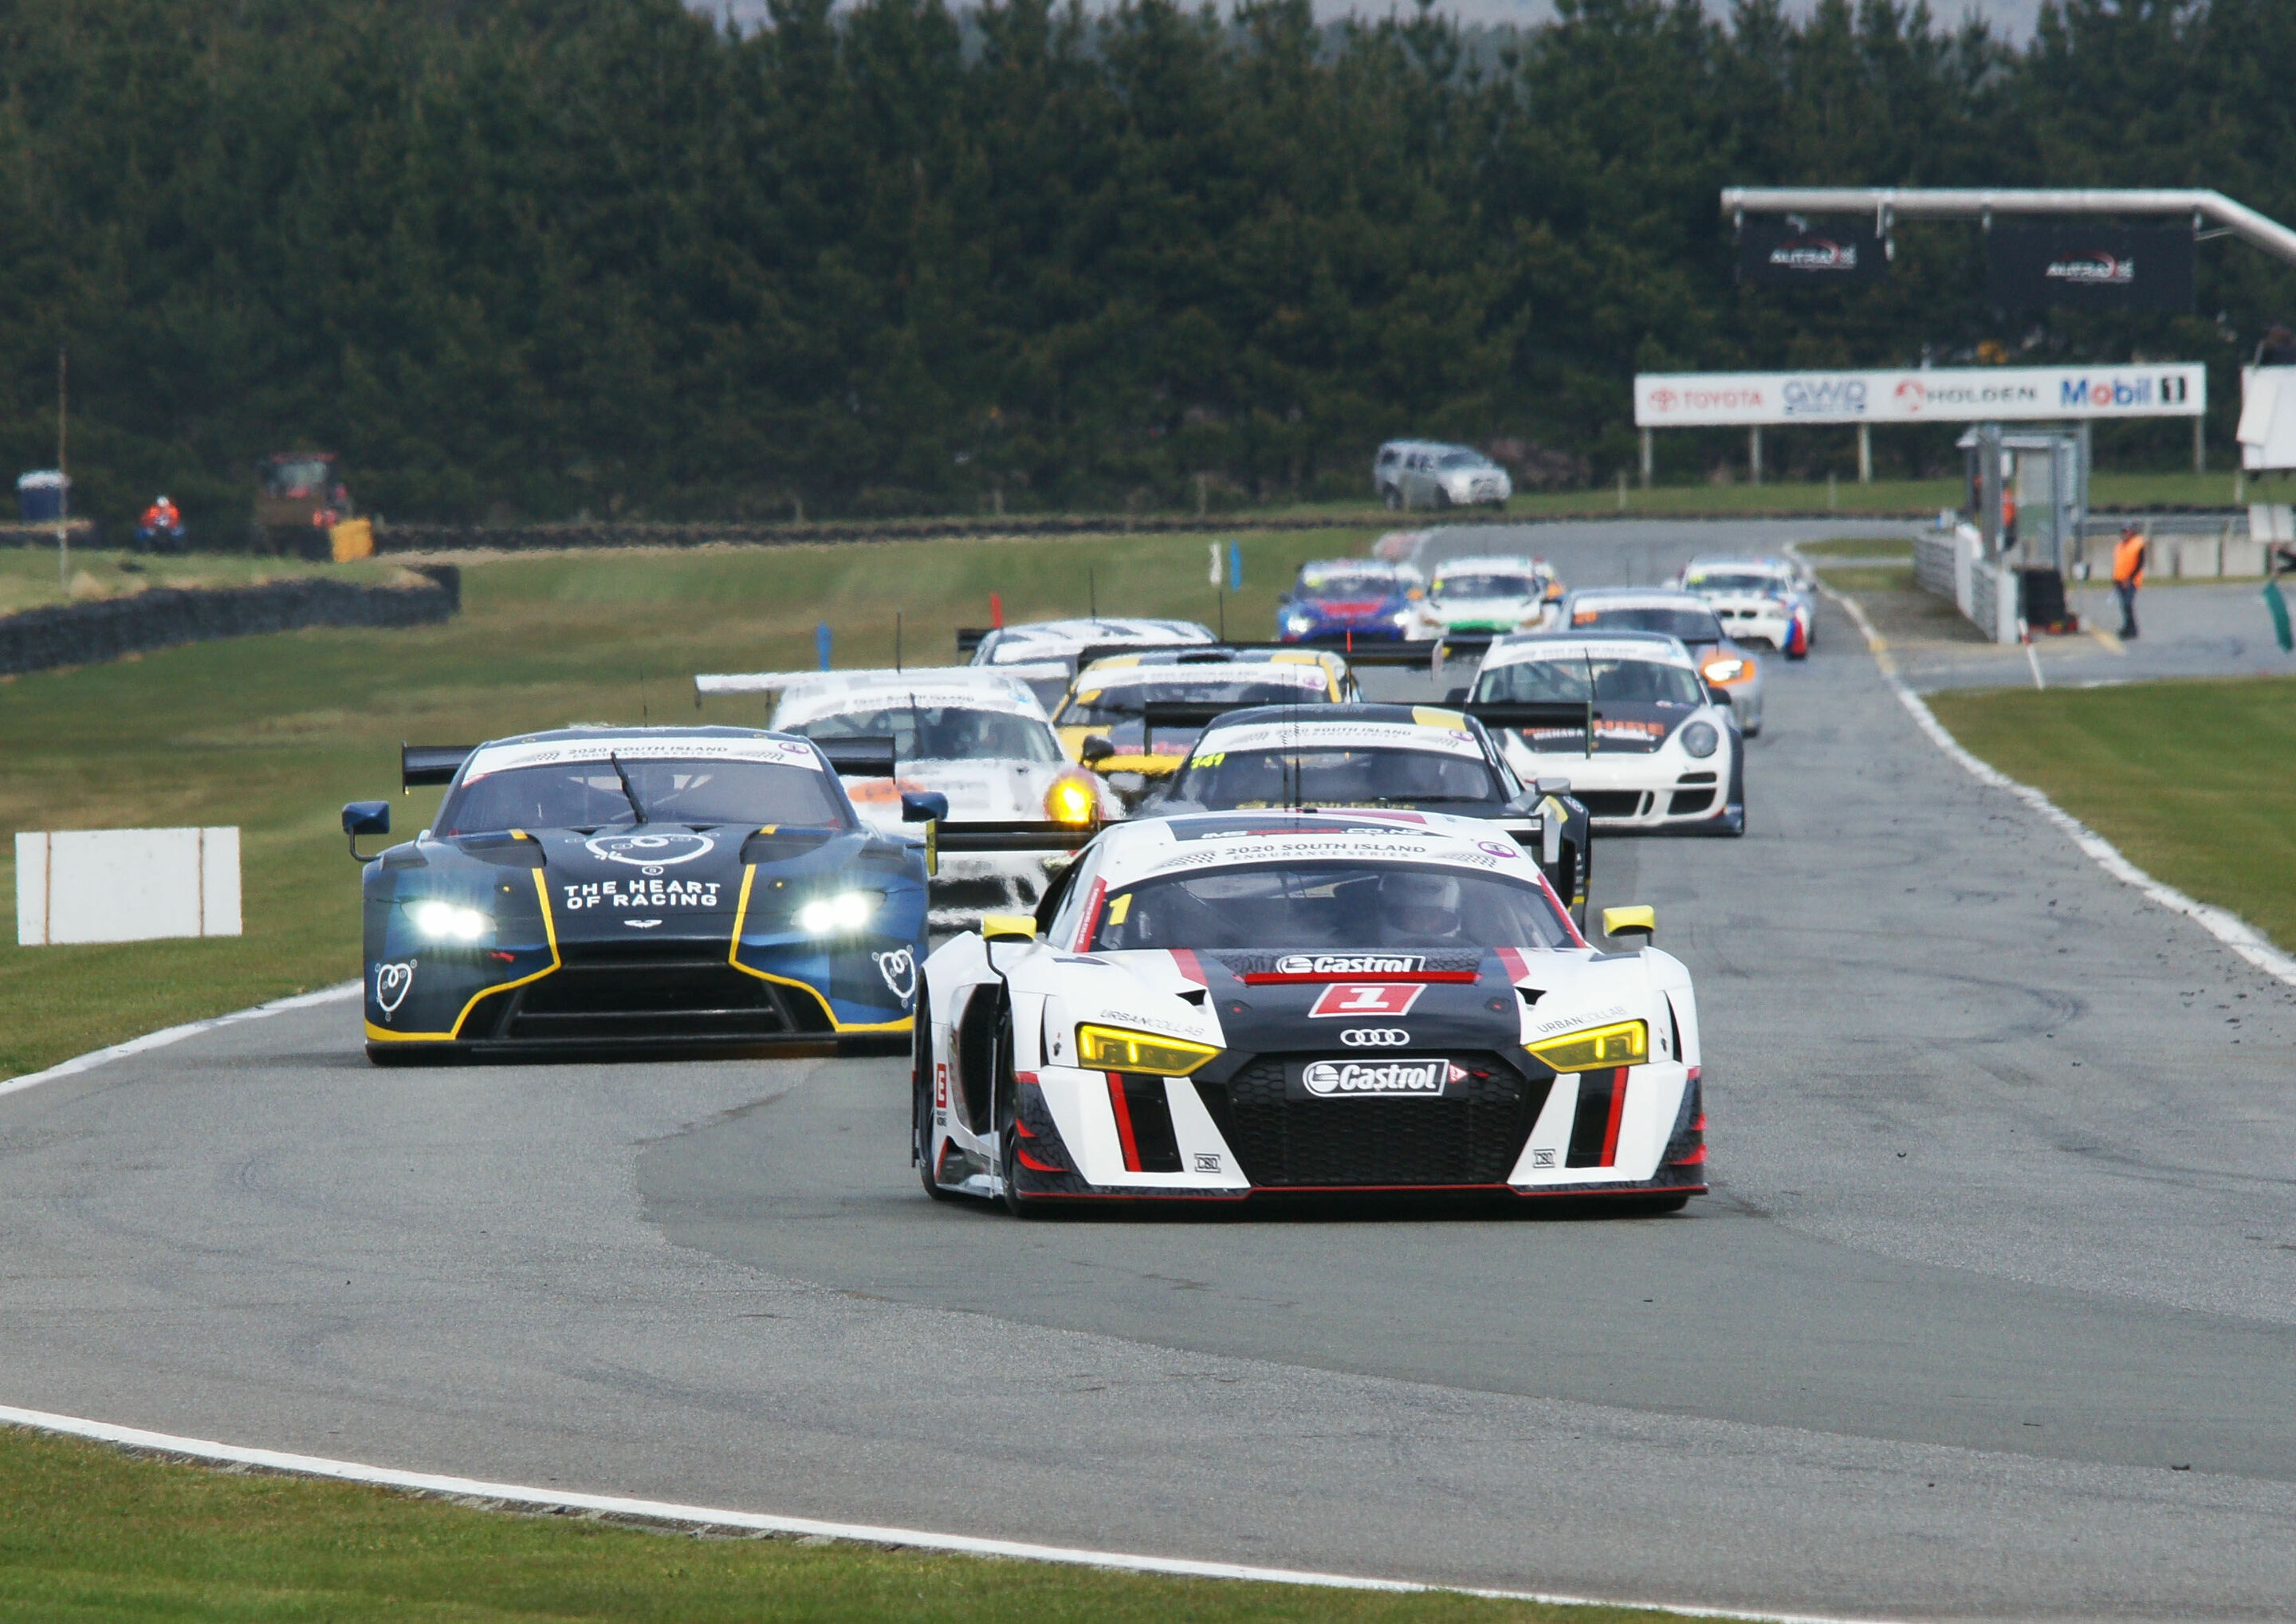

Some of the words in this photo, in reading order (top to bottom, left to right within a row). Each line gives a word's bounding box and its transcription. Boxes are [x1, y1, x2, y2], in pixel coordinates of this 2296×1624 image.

[1684, 390, 1763, 409] TOYOTA
[1928, 387, 2037, 404] HOLDEN
[2061, 377, 2150, 406] Mobil
[1225, 845, 1275, 855] 2020
[1354, 843, 1426, 853] ISLAND
[564, 881, 617, 897] THE
[629, 879, 721, 895] HEART
[567, 895, 601, 910] OF
[613, 894, 718, 906] RACING
[1109, 893, 1133, 926] 1
[1313, 956, 1413, 973] Castrol
[1339, 987, 1390, 1009] 1
[1536, 1006, 1627, 1033] URBANCOLLAB
[1339, 1064, 1437, 1091] Castrol
